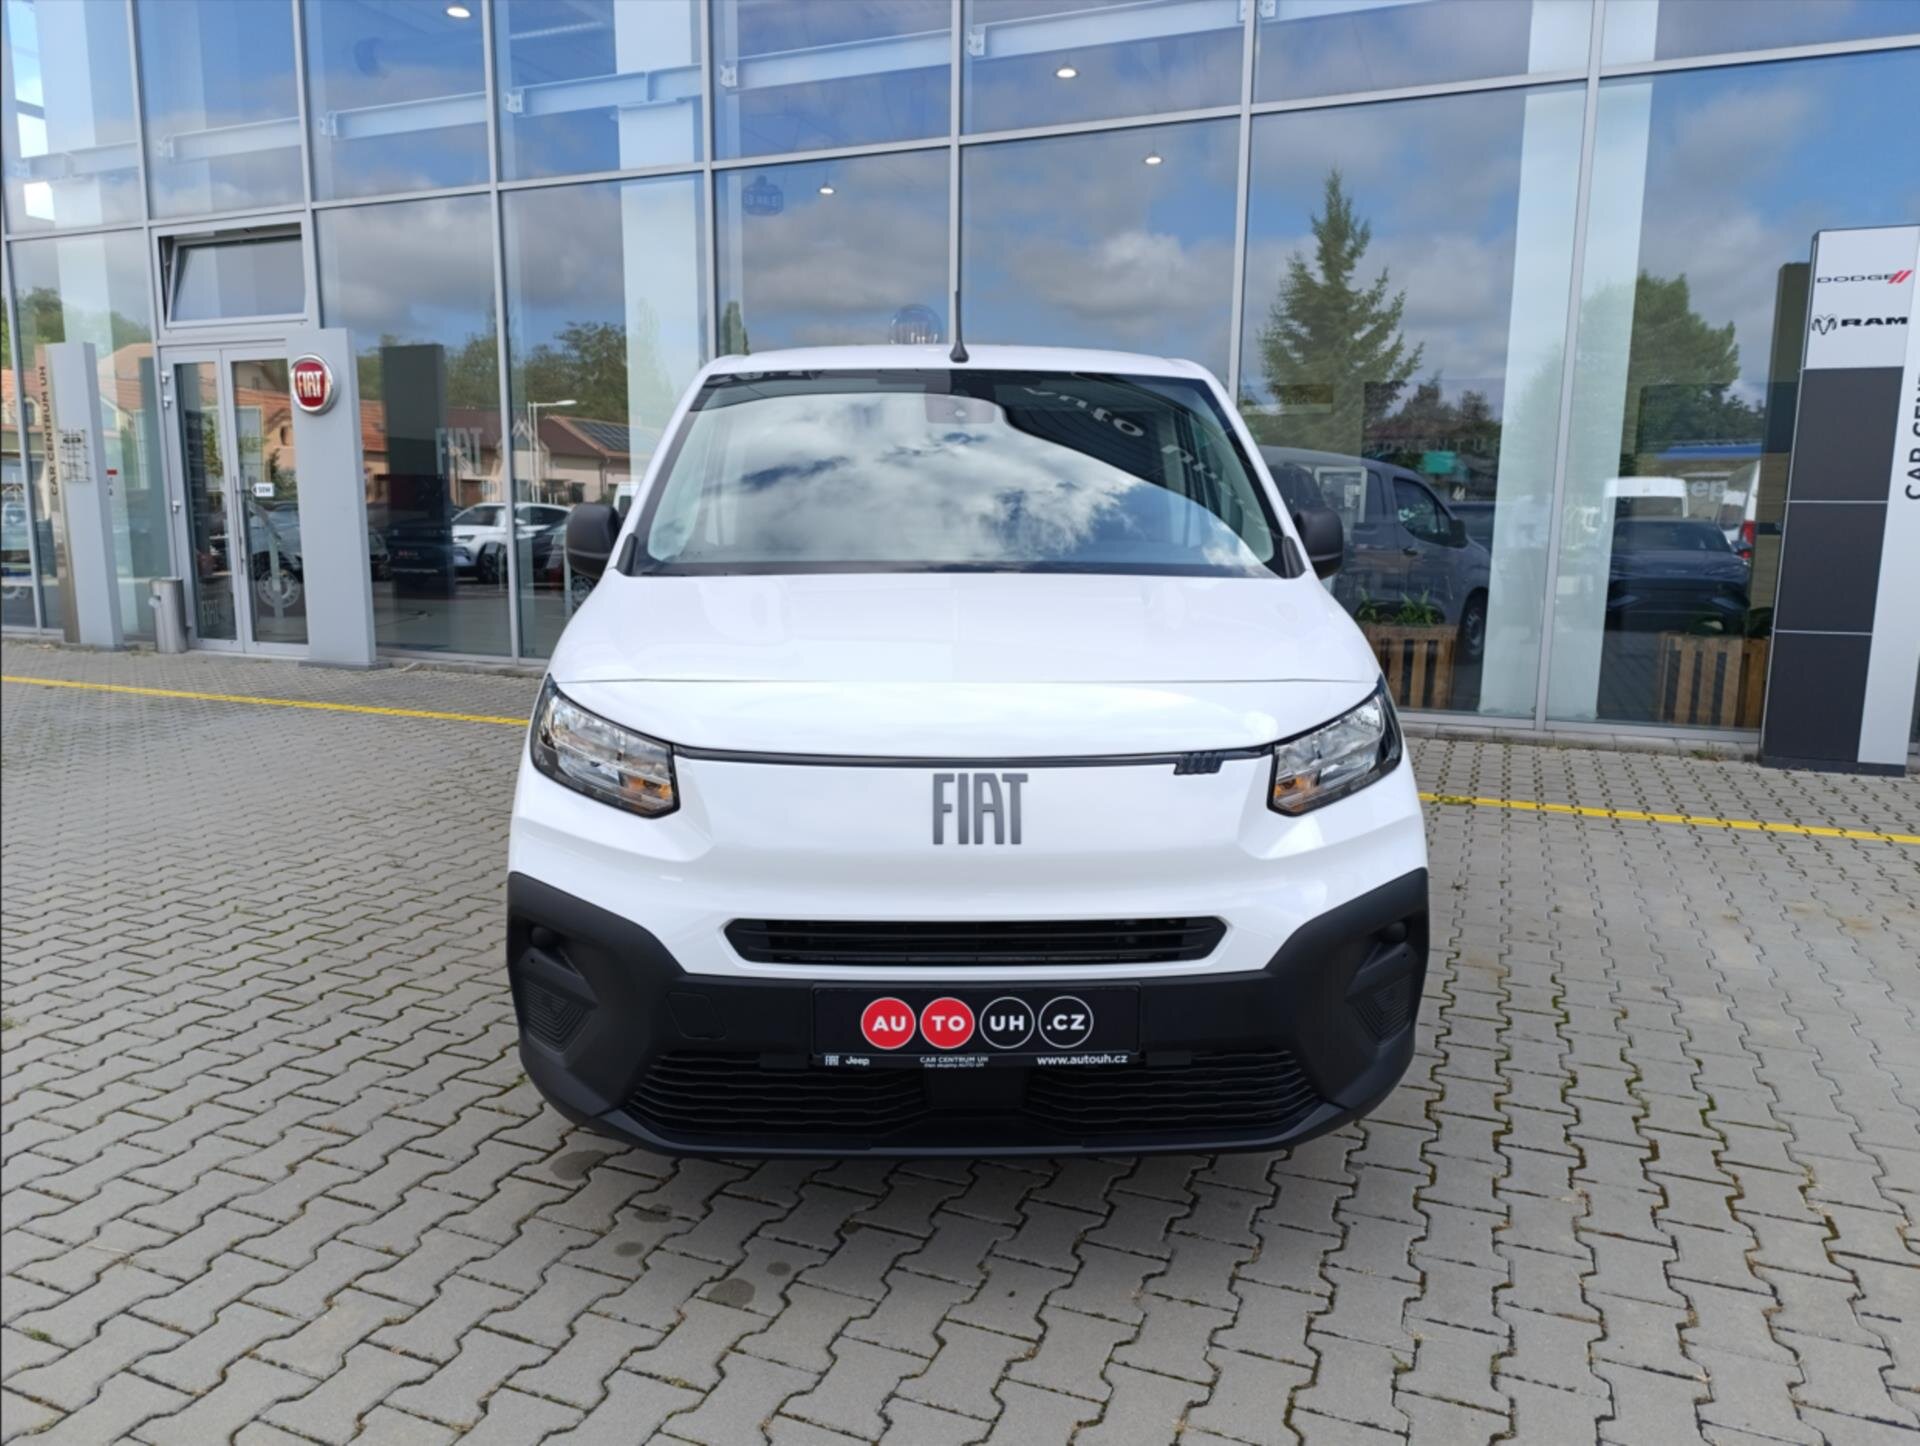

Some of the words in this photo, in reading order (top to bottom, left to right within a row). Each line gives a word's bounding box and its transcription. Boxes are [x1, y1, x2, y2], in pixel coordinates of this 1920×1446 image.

[1816, 273, 1896, 283] DODGE
[1841, 316, 1908, 327] RAM
[39, 366, 48, 386] UH
[296, 370, 323, 398] FIAT
[41, 391, 55, 461] CENTRUM
[435, 427, 484, 476] FIAT
[49, 466, 58, 496] CAR
[932, 773, 1028, 845] FIAT
[872, 1015, 907, 1032] AU
[931, 1015, 965, 1032] TO
[989, 1014, 1025, 1032] UH
[1046, 1013, 1086, 1031] .CZ
[845, 1056, 870, 1067] Jeep
[977, 1055, 989, 1063] UH
[1037, 1054, 1128, 1065] www.autouh.cz
